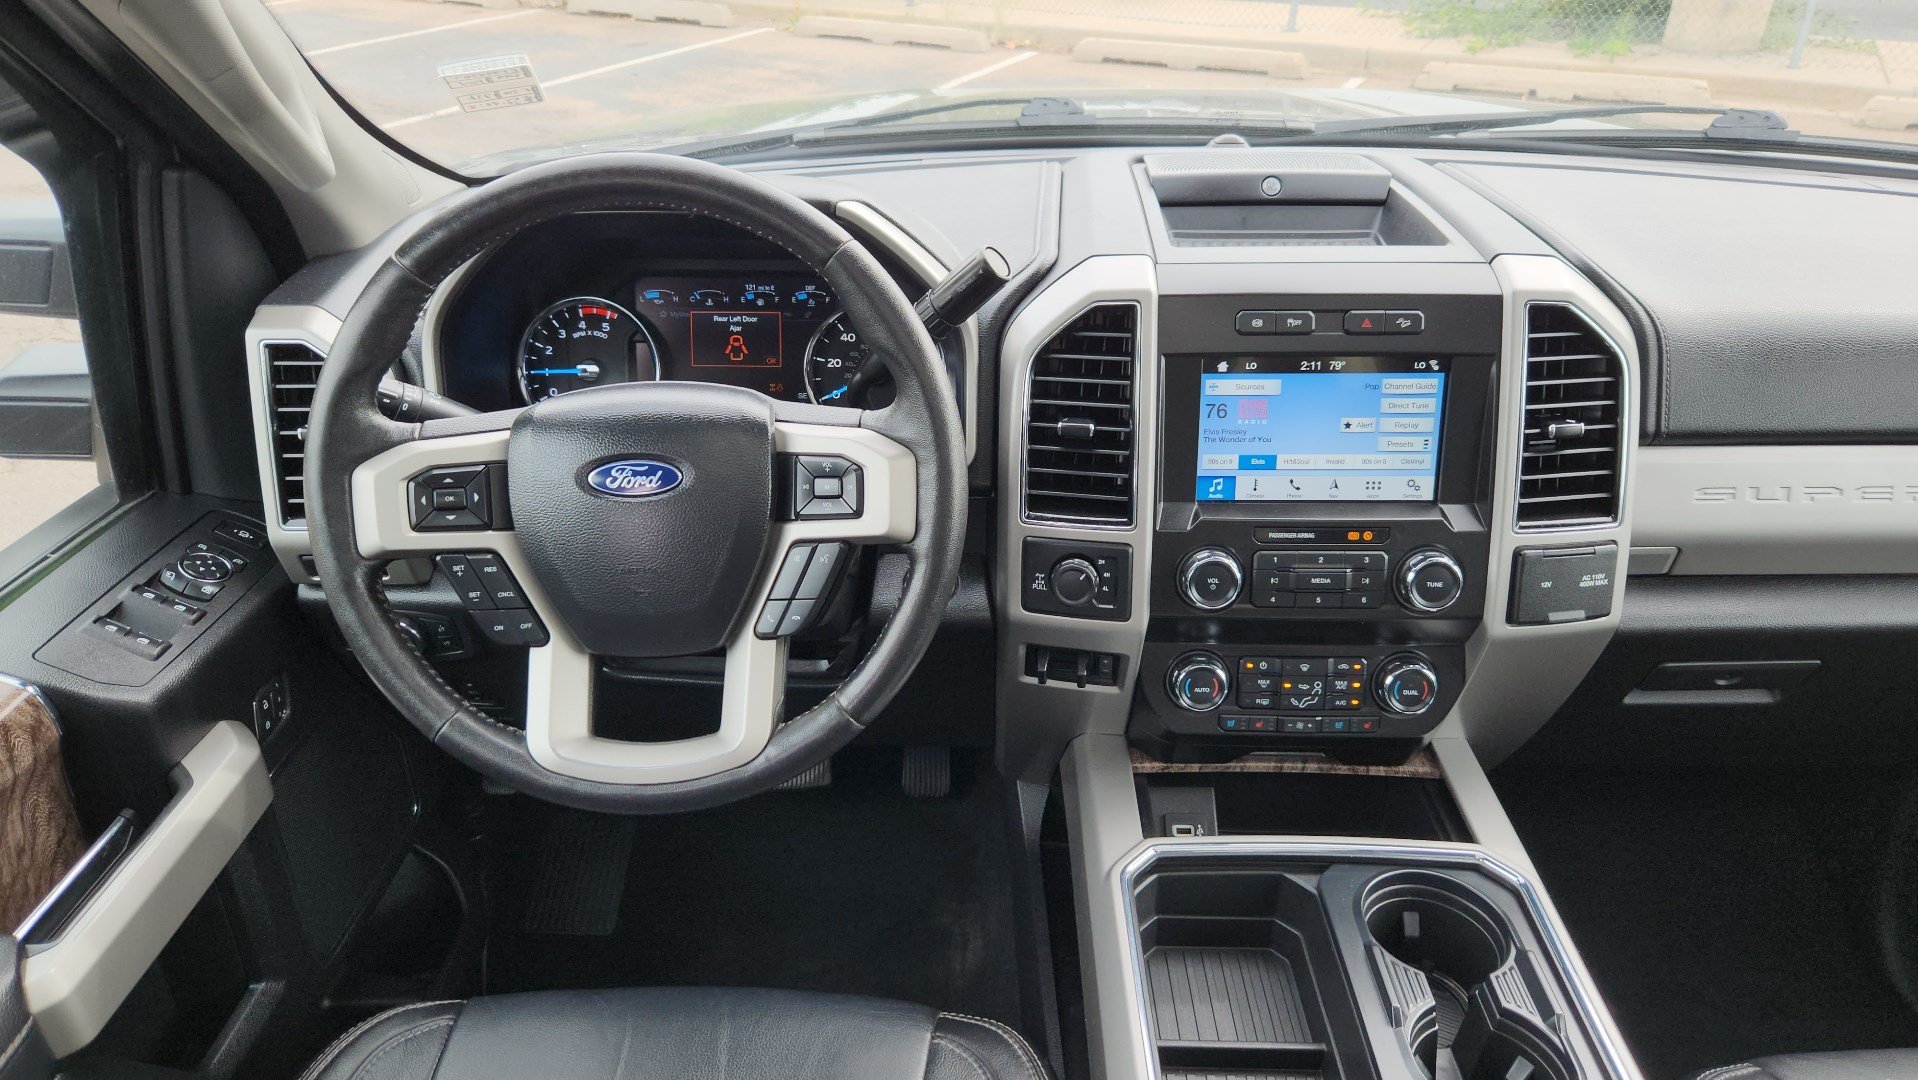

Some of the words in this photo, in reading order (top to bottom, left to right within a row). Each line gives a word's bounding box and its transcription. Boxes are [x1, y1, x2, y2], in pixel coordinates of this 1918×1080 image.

[578, 321, 587, 329] 4
[602, 323, 610, 332] 5
[558, 329, 566, 338] 3
[572, 331, 586, 339] RPM
[593, 330, 609, 339] 1000
[840, 333, 856, 342] 40
[545, 346, 553, 355] 2
[827, 358, 842, 368] 20
[1300, 361, 1321, 370] 2:11
[1329, 361, 1346, 370] 79°
[1235, 383, 1265, 391] Sources
[1365, 383, 1380, 391] Pop
[549, 388, 557, 396] 0
[1205, 403, 1228, 419] 76
[1394, 422, 1419, 430] Replay
[1221, 428, 1247, 437] Presley
[1387, 440, 1414, 448] Presets
[605, 465, 663, 489] Ford
[1032, 583, 1047, 591] PULL
[1579, 580, 1595, 588] 400W
[1595, 578, 1609, 586] MAX
